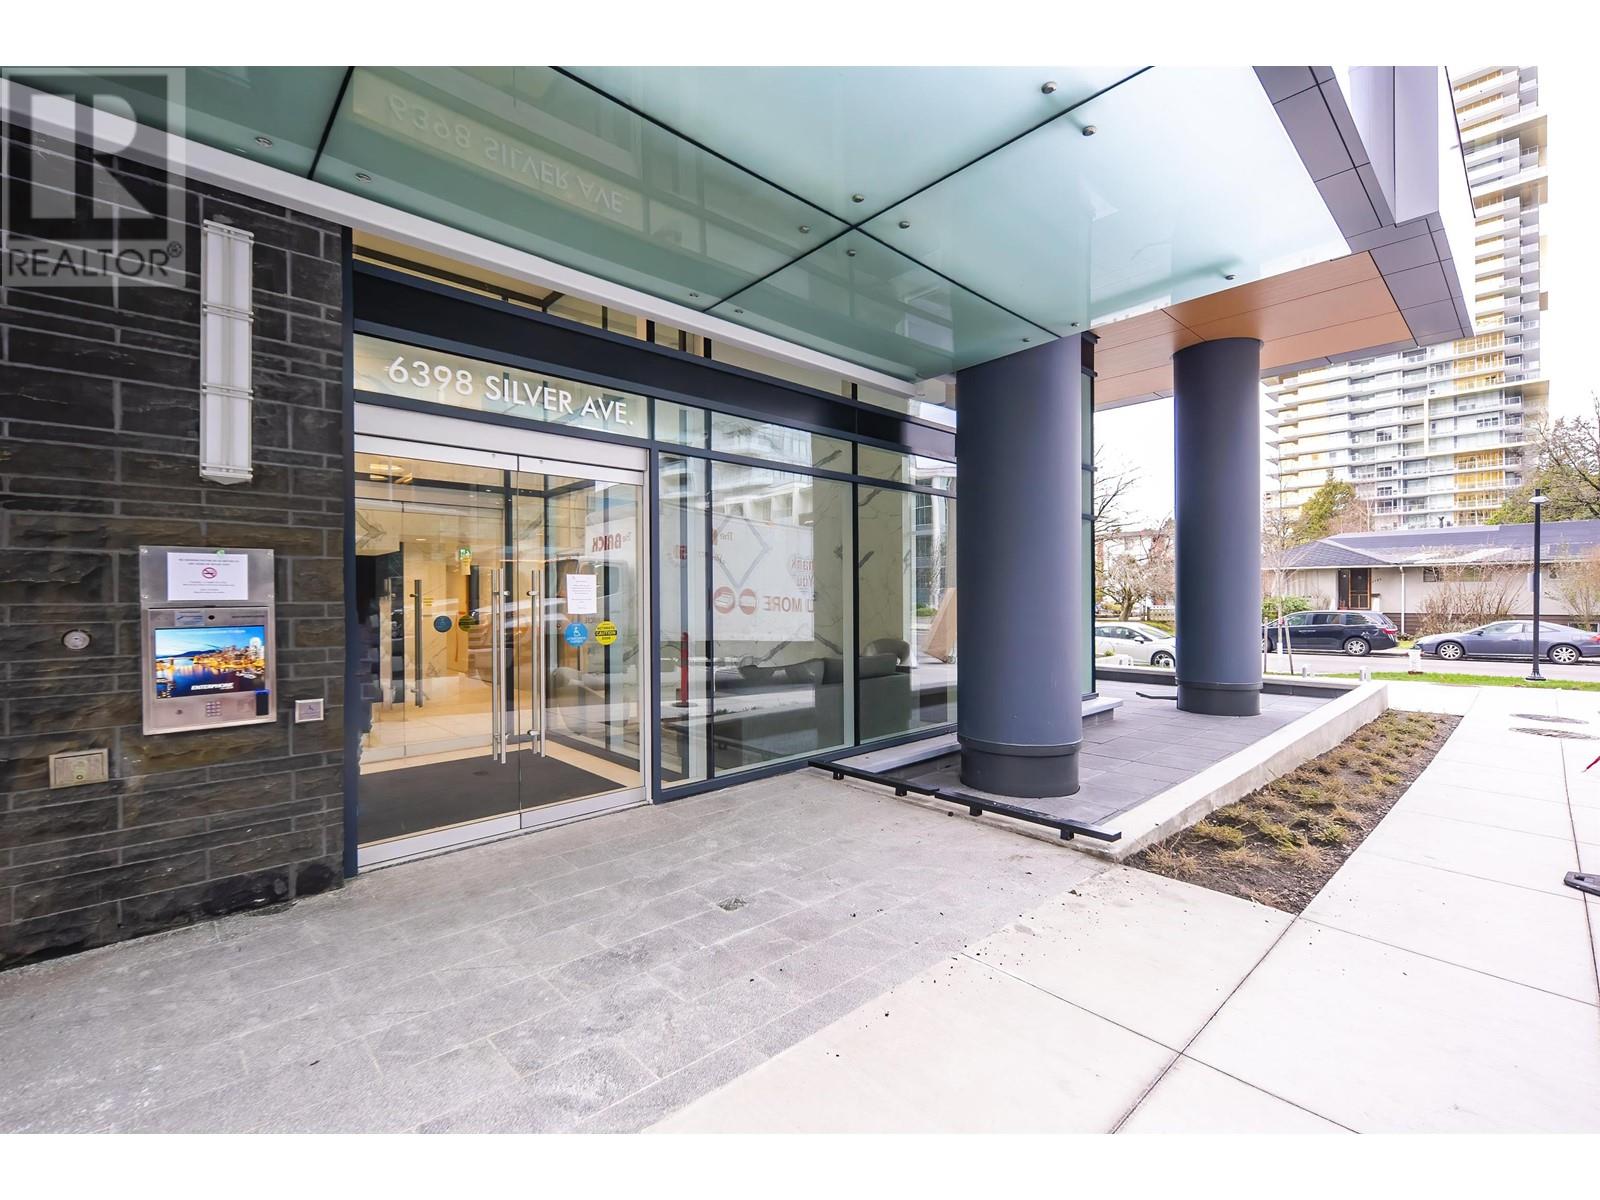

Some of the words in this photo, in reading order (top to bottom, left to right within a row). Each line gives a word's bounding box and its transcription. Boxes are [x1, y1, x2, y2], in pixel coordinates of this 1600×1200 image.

[387, 356, 473, 396] 6398
[485, 375, 574, 415] SILVER
[580, 395, 634, 426] AVE.
